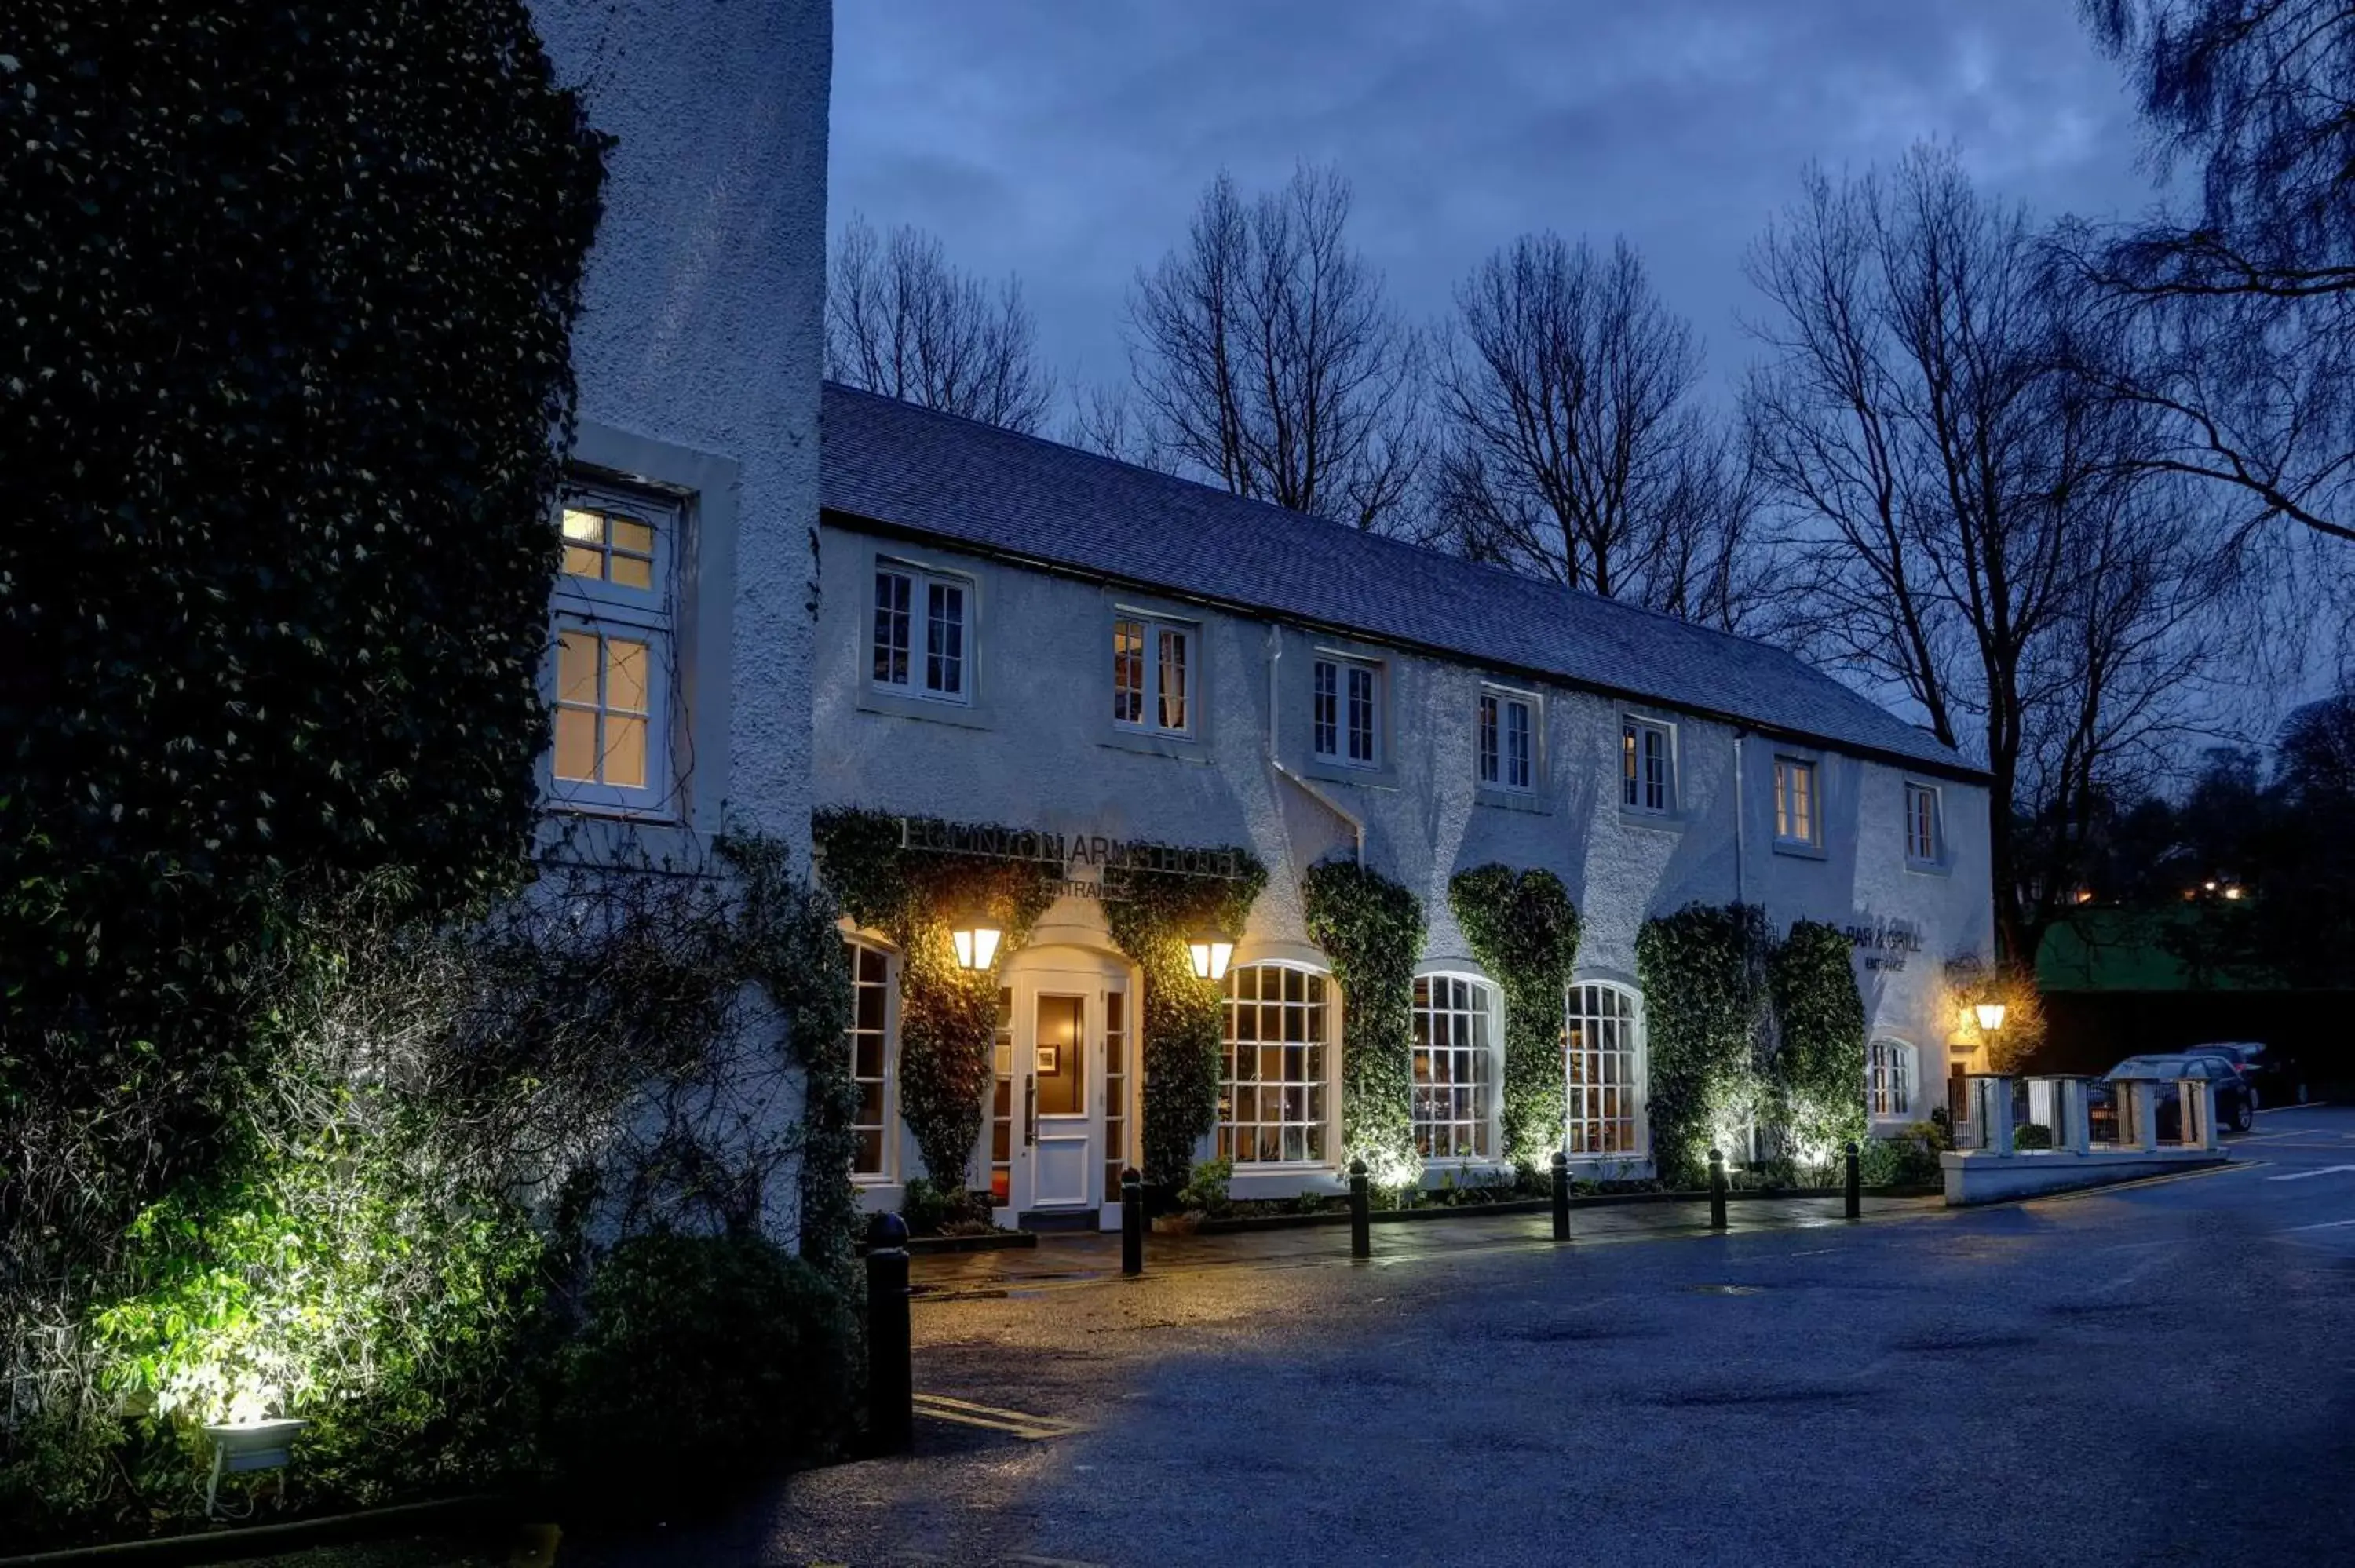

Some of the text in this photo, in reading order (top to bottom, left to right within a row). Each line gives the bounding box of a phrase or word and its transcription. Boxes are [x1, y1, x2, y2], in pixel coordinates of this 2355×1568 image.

[1070, 834, 1153, 868] ARMS
[1846, 926, 1872, 947] BAR
[1887, 931, 1921, 952] GRILL
